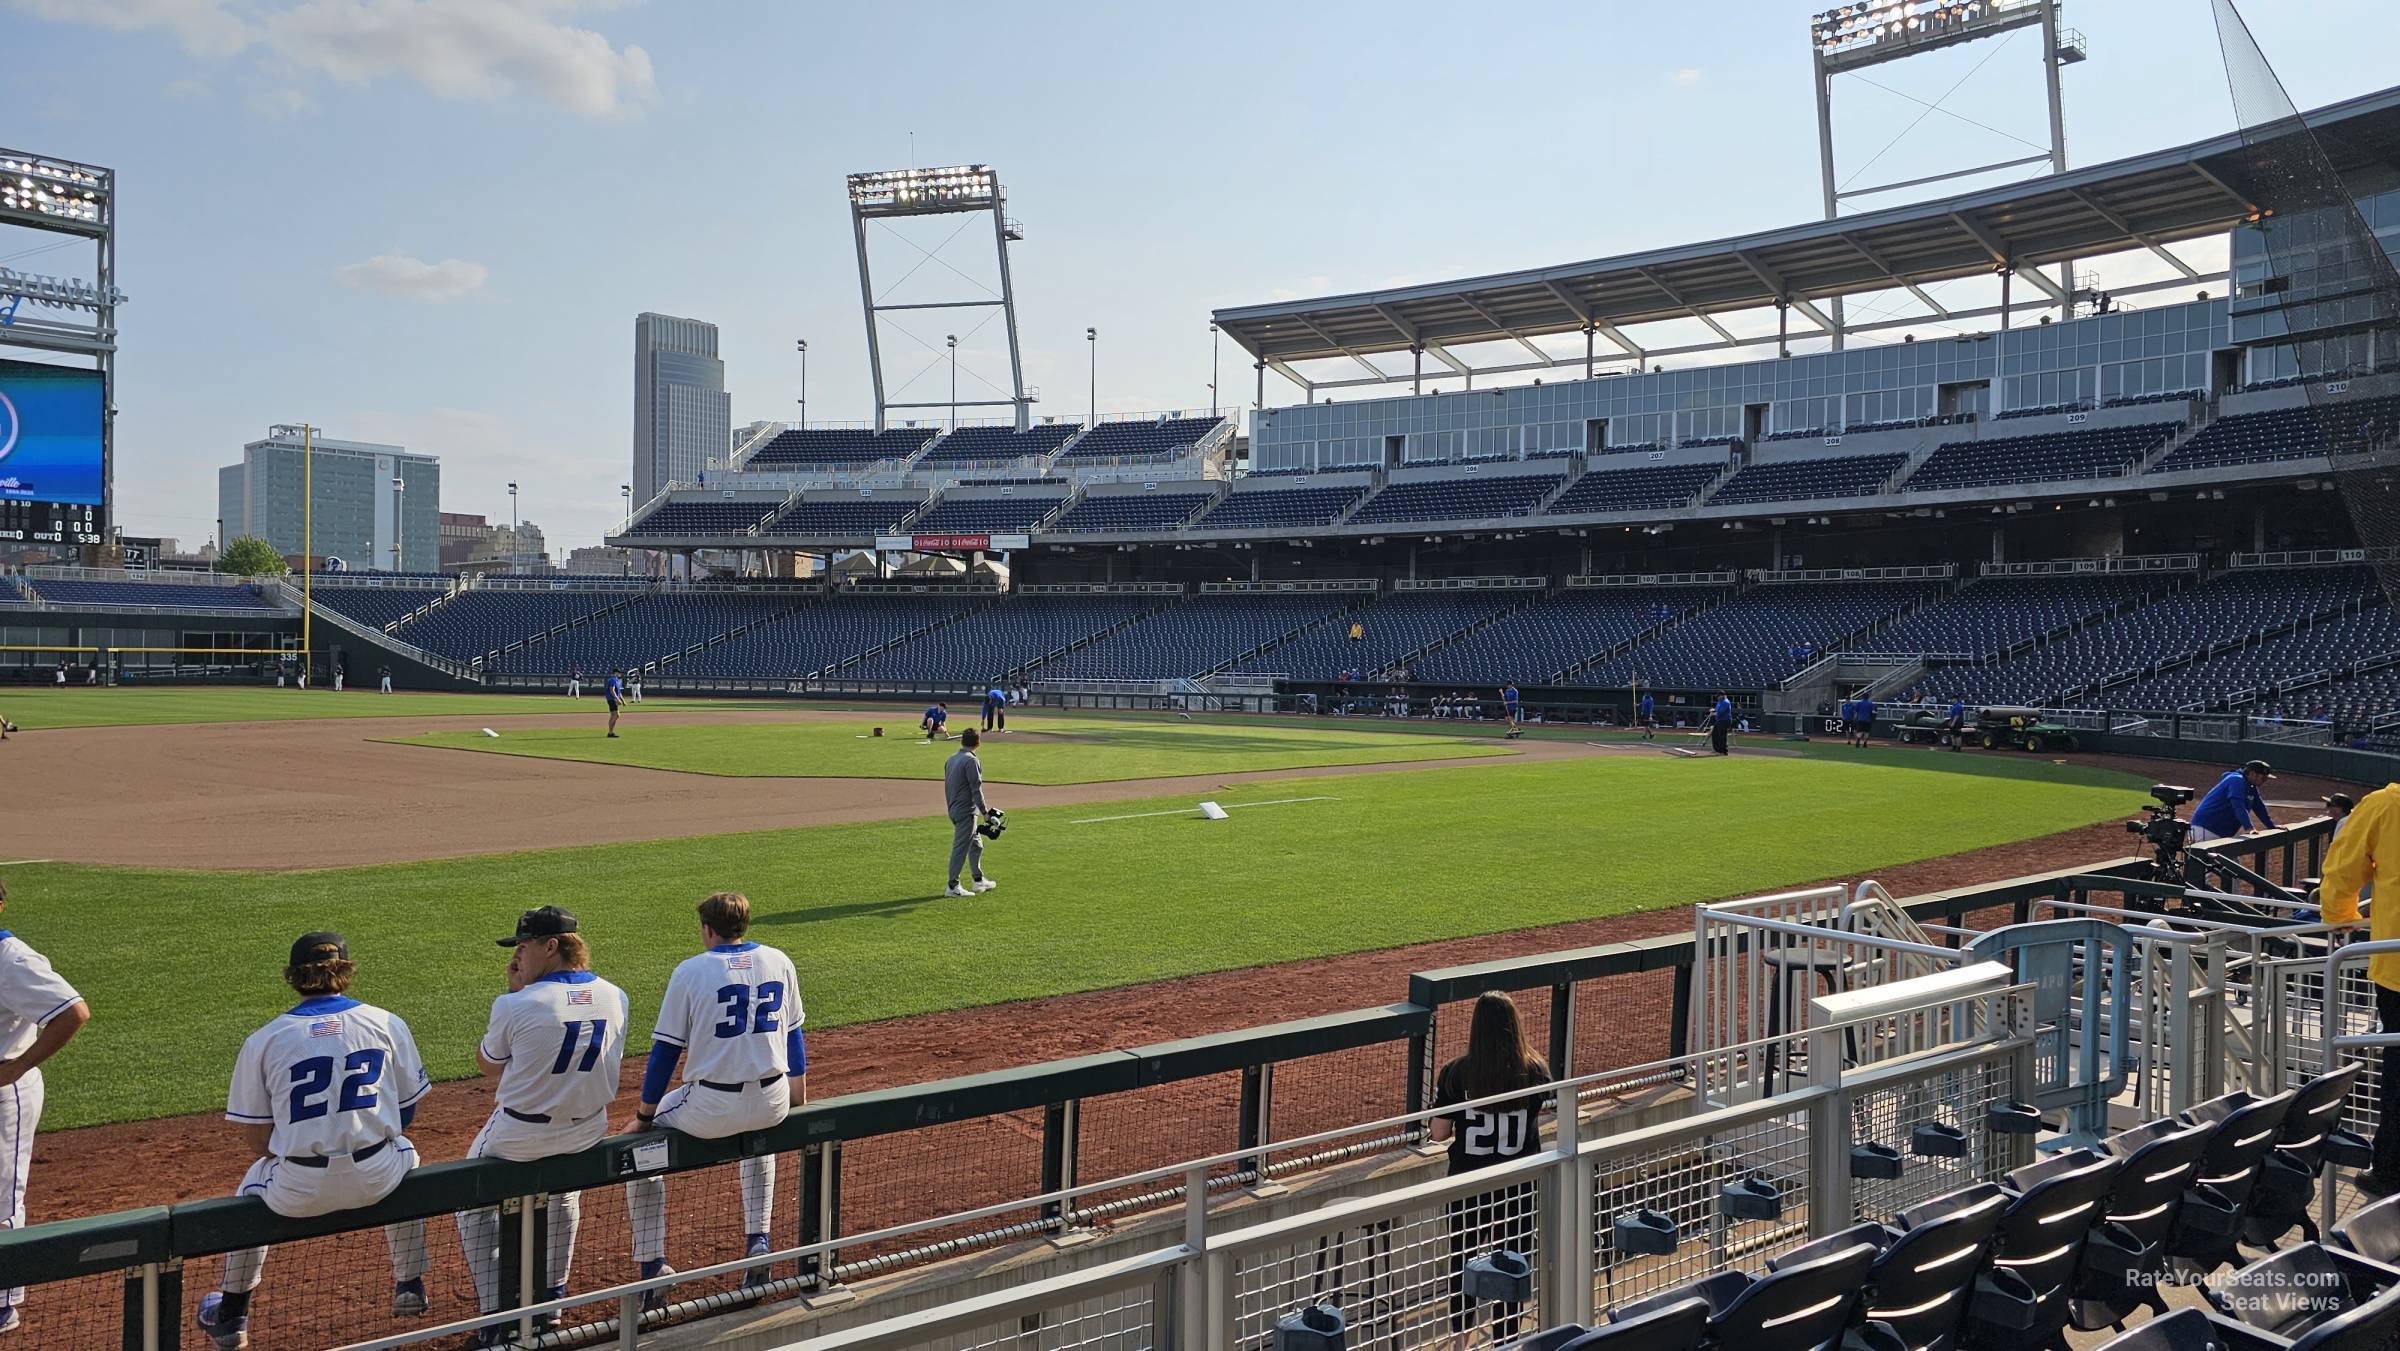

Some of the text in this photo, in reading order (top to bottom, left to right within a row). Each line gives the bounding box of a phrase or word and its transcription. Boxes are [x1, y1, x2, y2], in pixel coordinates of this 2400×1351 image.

[2328, 383, 2347, 393] 210
[2070, 413, 2085, 422] 209
[85, 511, 92, 521] 0
[56, 520, 92, 532] 0 0 0
[16, 530, 23, 540] 0
[34, 532, 54, 540] OUT
[54, 532, 62, 542] 0
[78, 533, 100, 543] 5:38
[2345, 551, 2361, 559] 110
[2080, 562, 2095, 571] 109
[280, 653, 297, 661] 335
[1826, 719, 1852, 732] 0:2
[714, 980, 785, 1039] 32
[551, 1019, 607, 1075] 11
[289, 1048, 386, 1125] 22
[1465, 1107, 1528, 1156] 20
